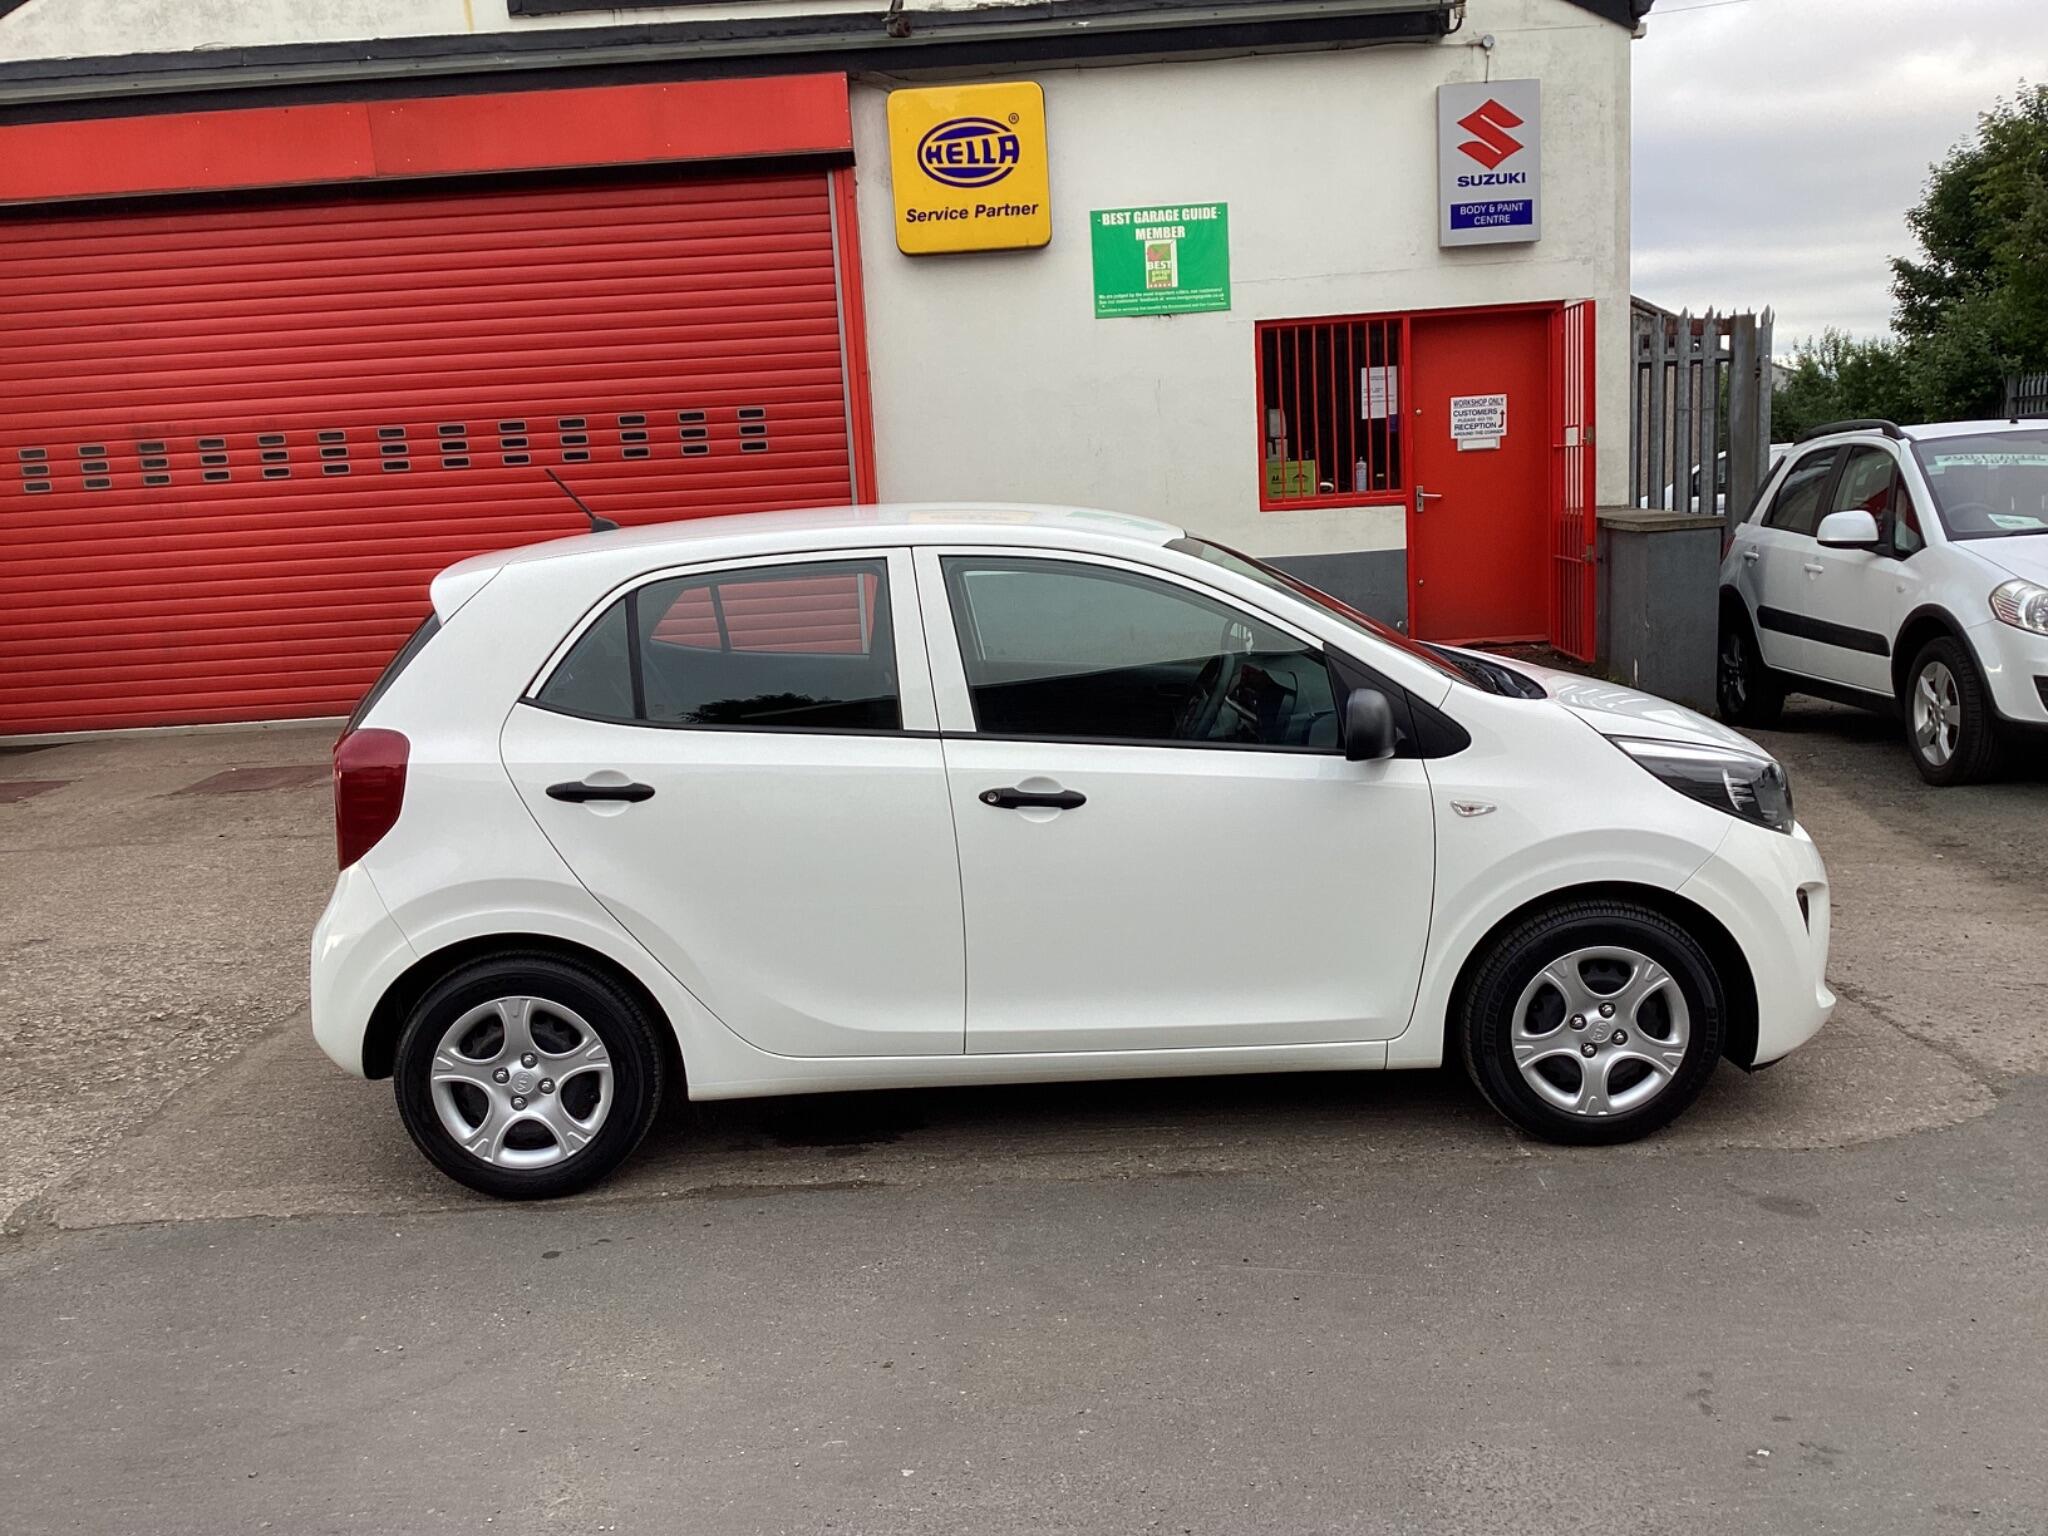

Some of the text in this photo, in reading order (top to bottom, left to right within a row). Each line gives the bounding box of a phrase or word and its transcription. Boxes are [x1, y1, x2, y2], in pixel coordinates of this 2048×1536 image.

[925, 134, 1020, 165] HELLA
[1457, 172, 1526, 188] SUZUKI
[906, 202, 1039, 223] Service Partner
[1102, 206, 1218, 226] BEST GARAGE GUIDE
[1460, 202, 1524, 216] BODY & PAINT
[1474, 214, 1511, 226] CENTRE
[1135, 226, 1185, 241] MEMBER
